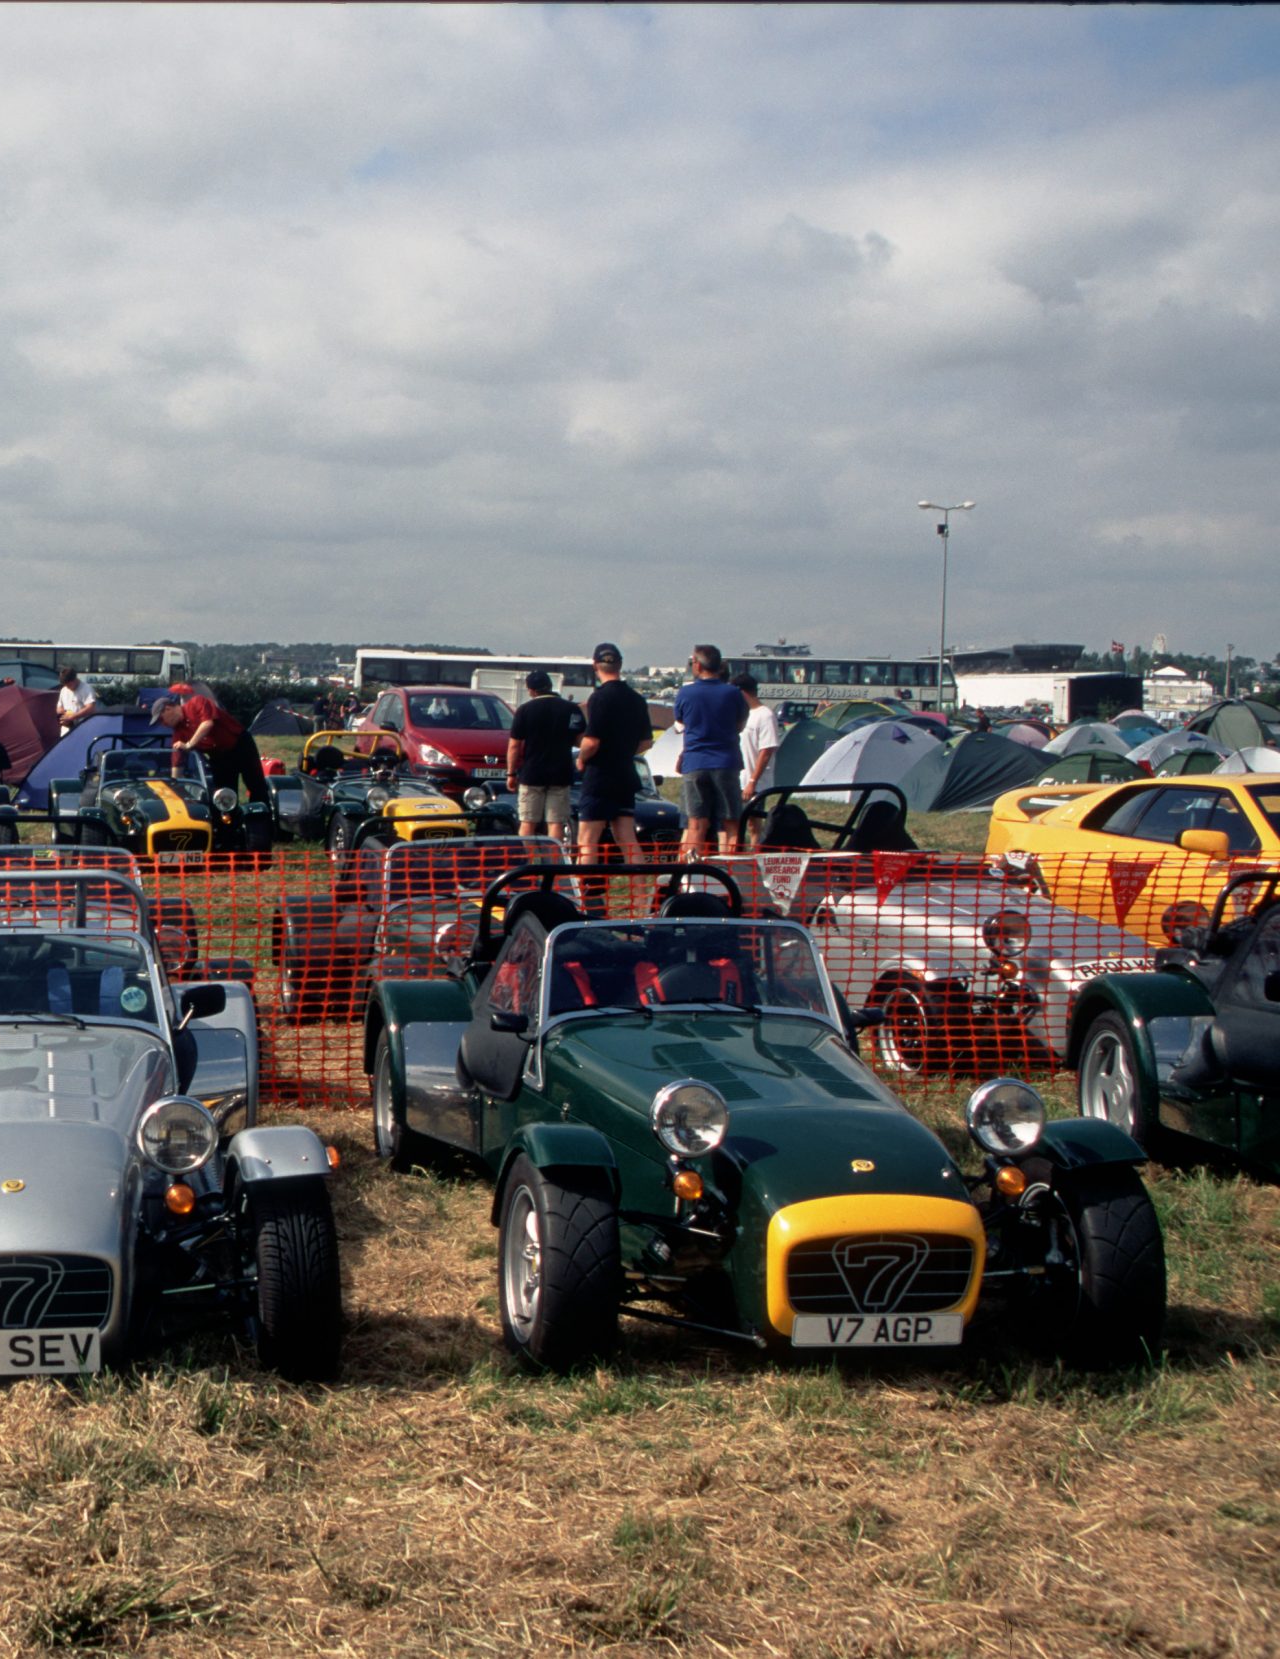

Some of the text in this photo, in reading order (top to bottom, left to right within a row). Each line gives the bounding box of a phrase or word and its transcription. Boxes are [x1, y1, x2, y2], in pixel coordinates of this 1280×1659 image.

[169, 831, 193, 852] 7
[772, 875, 791, 884] FUND
[844, 1242, 918, 1306] 7
[827, 1318, 933, 1343] V7 AGP
[9, 1333, 94, 1367] SEV
